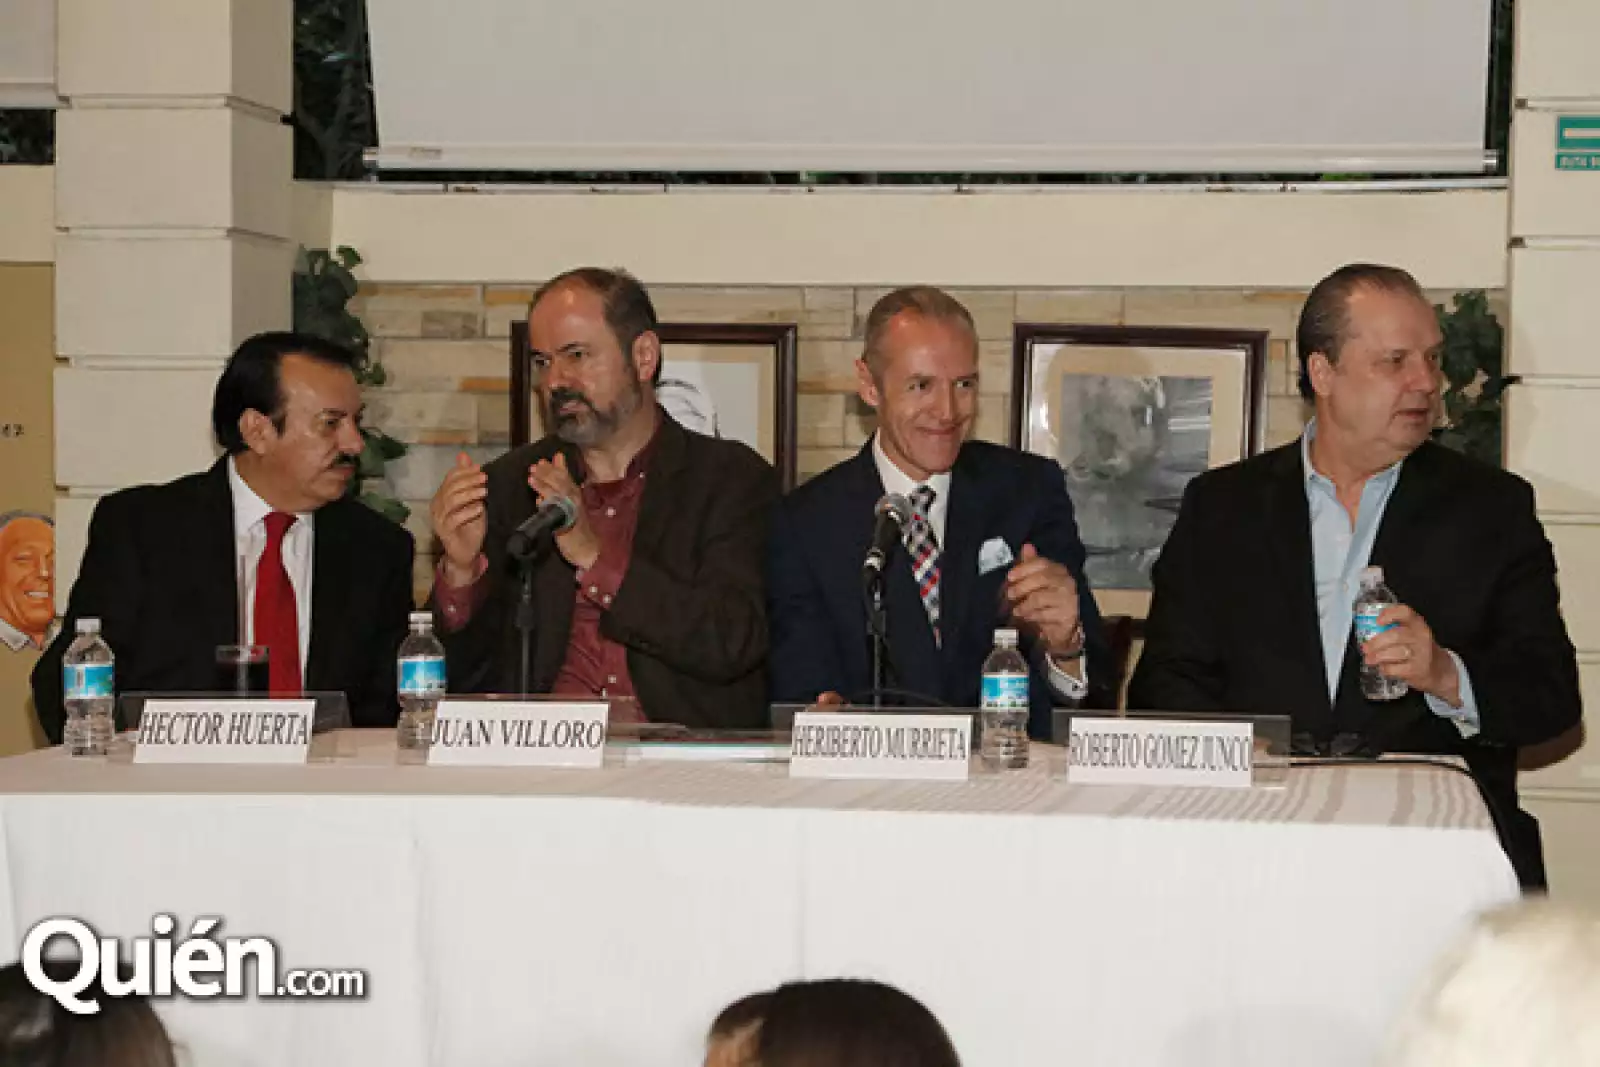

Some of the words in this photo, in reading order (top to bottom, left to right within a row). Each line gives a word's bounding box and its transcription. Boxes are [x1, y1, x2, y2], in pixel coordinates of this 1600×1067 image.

[138, 712, 224, 744] HECTOR
[227, 712, 307, 744] HUERTA
[431, 719, 495, 747] JUAN
[501, 719, 603, 749] VILLORO
[792, 725, 882, 758] HERIBERTO
[885, 727, 966, 760] MURRIETA
[1070, 731, 1138, 768] ROBERTO
